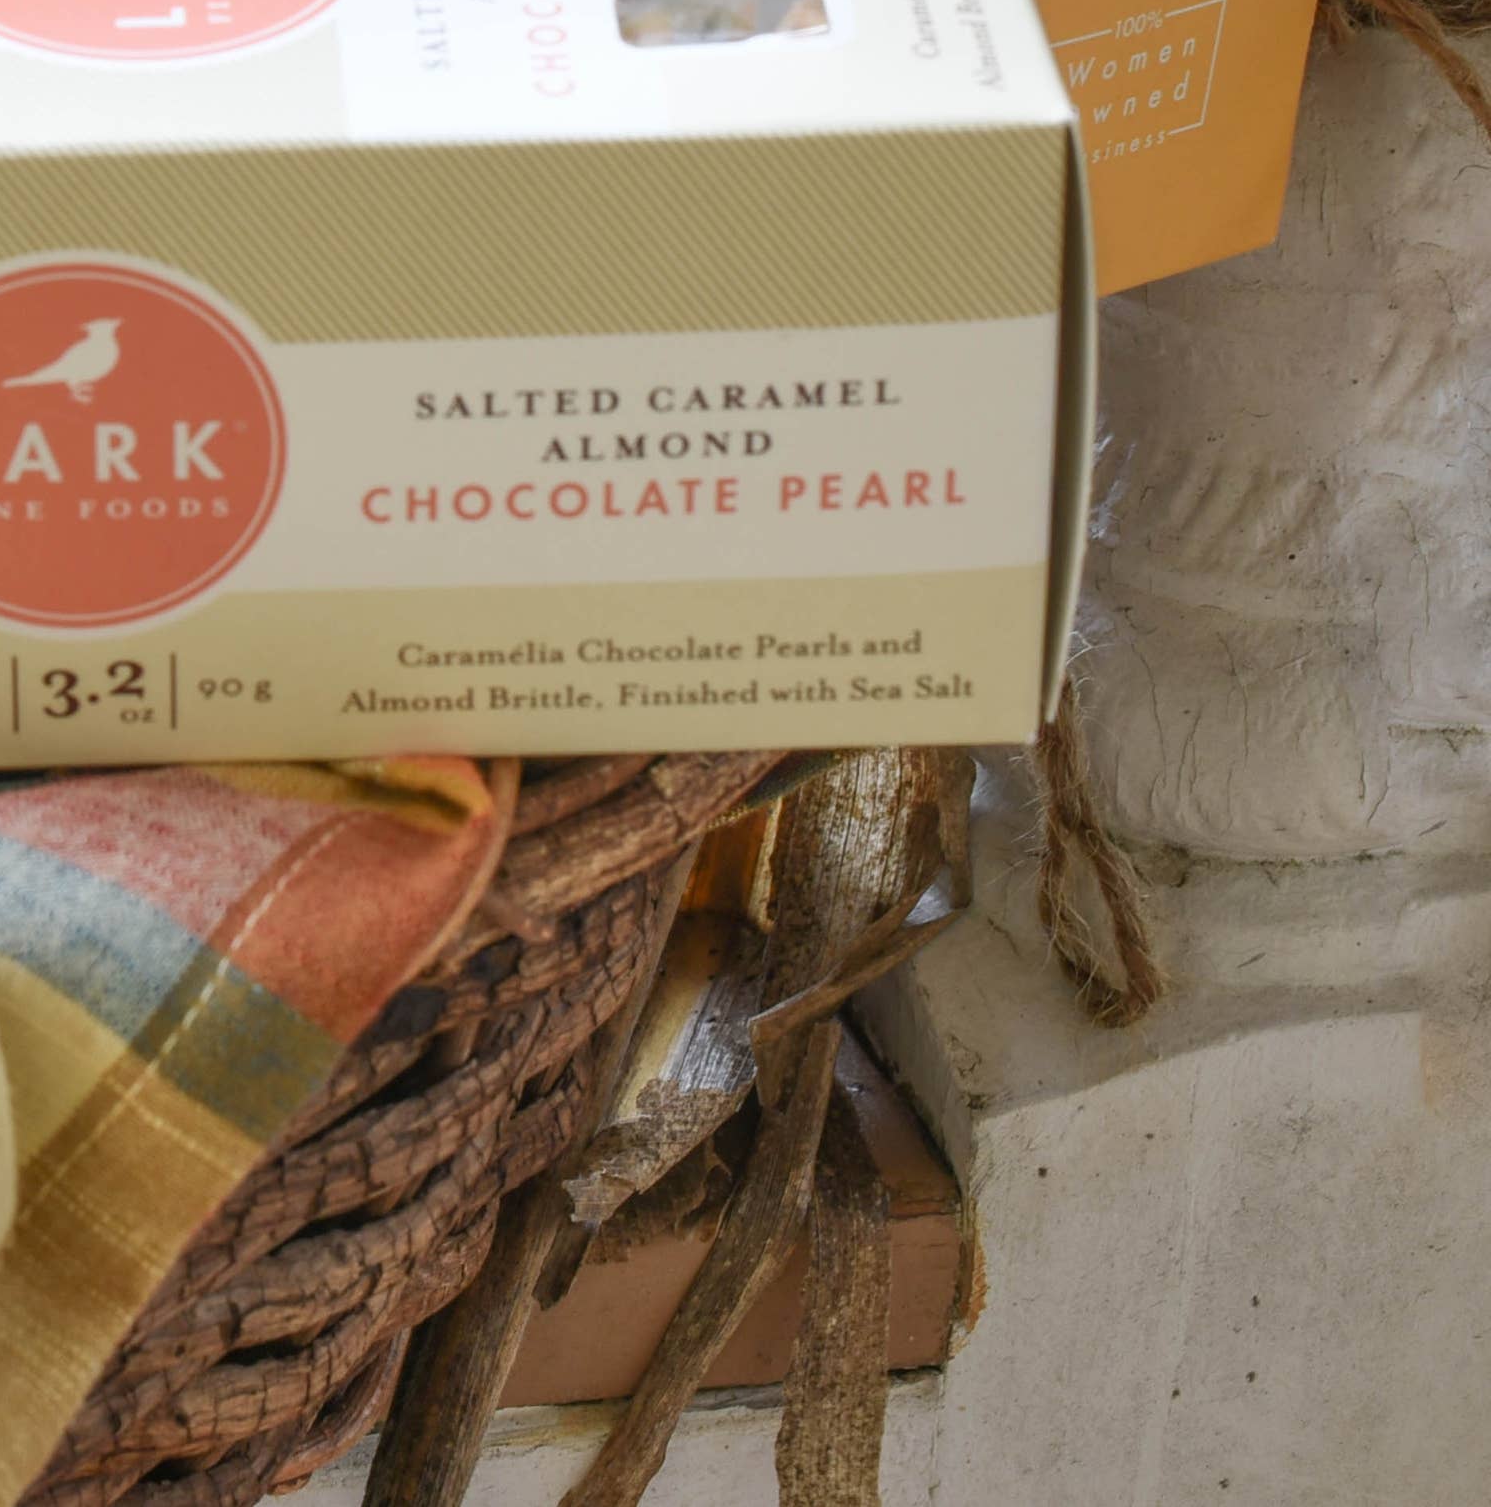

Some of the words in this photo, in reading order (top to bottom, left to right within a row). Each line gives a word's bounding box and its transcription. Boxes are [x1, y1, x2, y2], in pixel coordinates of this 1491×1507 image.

[1115, 9, 1164, 39] 100%
[1068, 37, 1196, 89] Women
[1093, 70, 1191, 124] wned
[1092, 129, 1165, 164] siness
[415, 389, 621, 420] SALTED
[647, 379, 903, 413] CARAMEL
[540, 430, 775, 463] ALMOND
[79, 498, 230, 520] FOODS
[360, 478, 739, 523] CHOCOLATE
[779, 469, 967, 511] PEARL
[576, 635, 743, 664] Chocolate
[755, 632, 852, 661] Pearls
[862, 630, 923, 657] and
[42, 660, 146, 719] 3.2
[198, 679, 243, 702] 90
[341, 687, 476, 715] Almond
[488, 683, 604, 715] Brittle,
[618, 678, 760, 708] Finished
[769, 676, 838, 704] with
[848, 673, 904, 702] Sea
[914, 671, 976, 700] Salt
